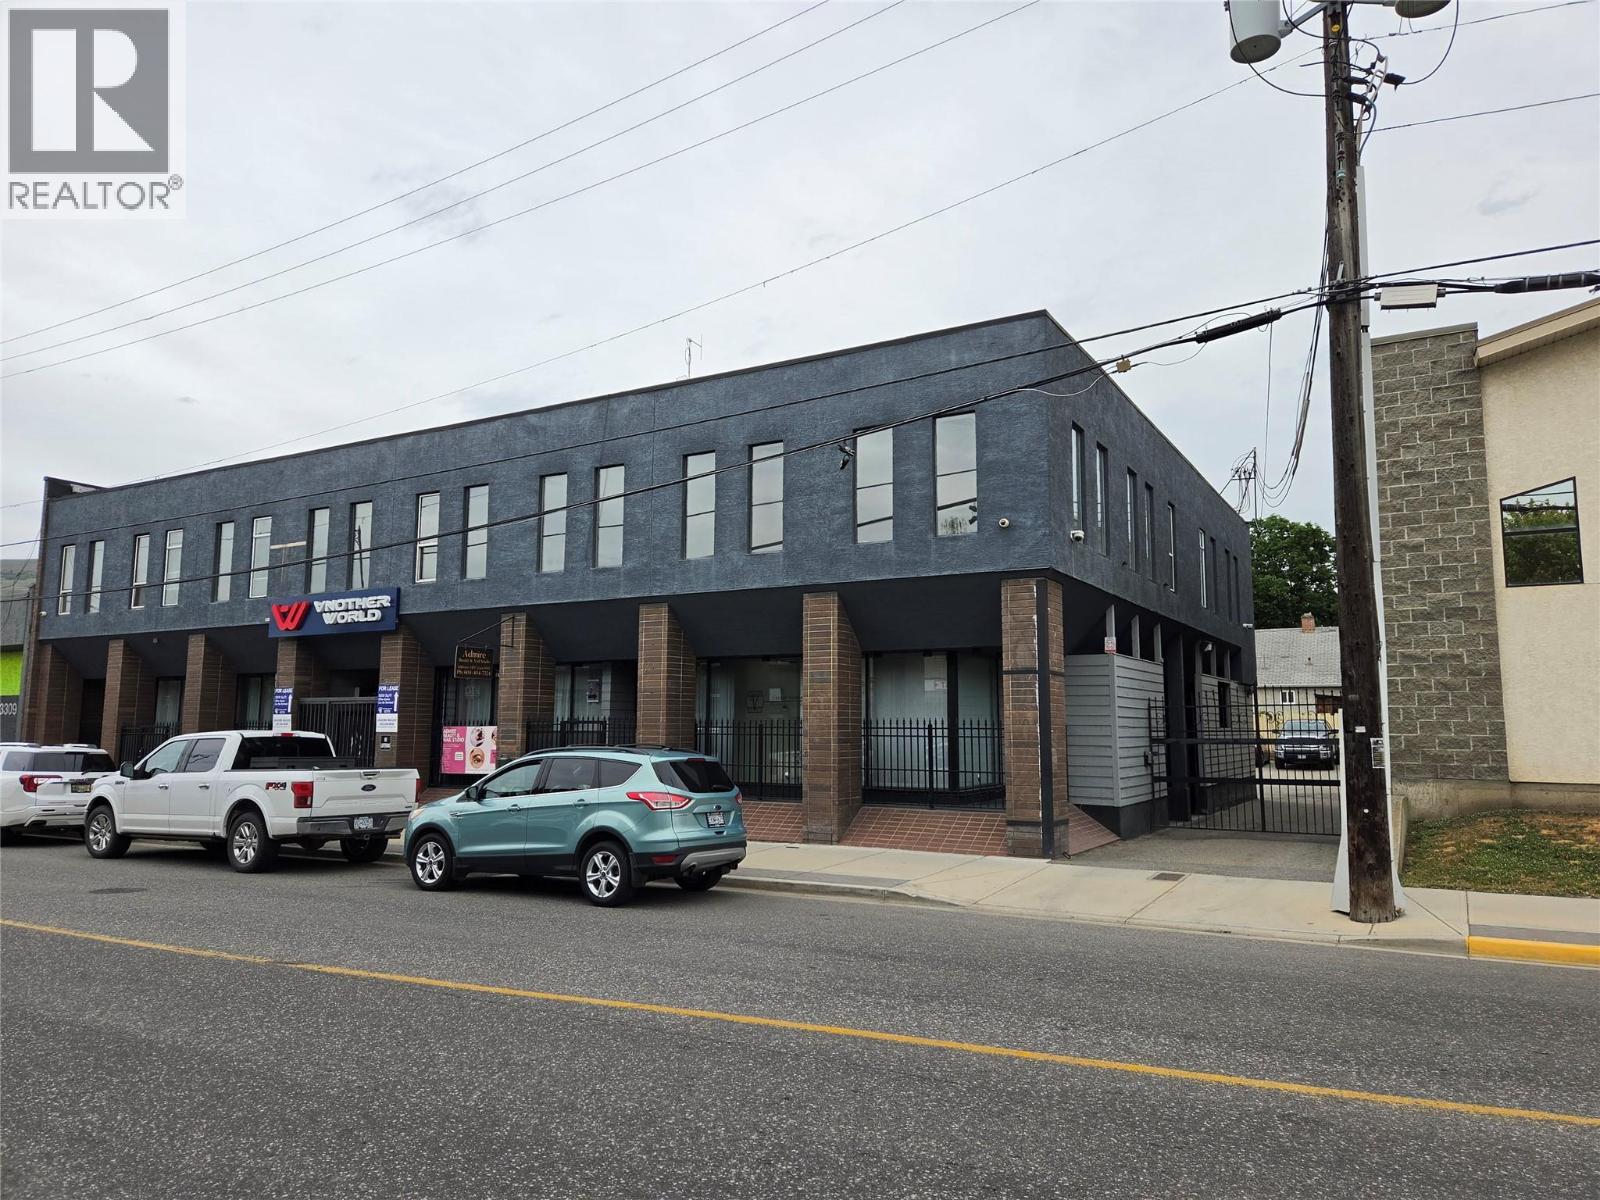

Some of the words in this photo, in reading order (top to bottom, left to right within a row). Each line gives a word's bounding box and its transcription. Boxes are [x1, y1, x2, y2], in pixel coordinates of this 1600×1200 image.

[322, 609, 381, 625] WORLD
[0, 702, 17, 715] 3309
[265, 782, 287, 790] FX4
